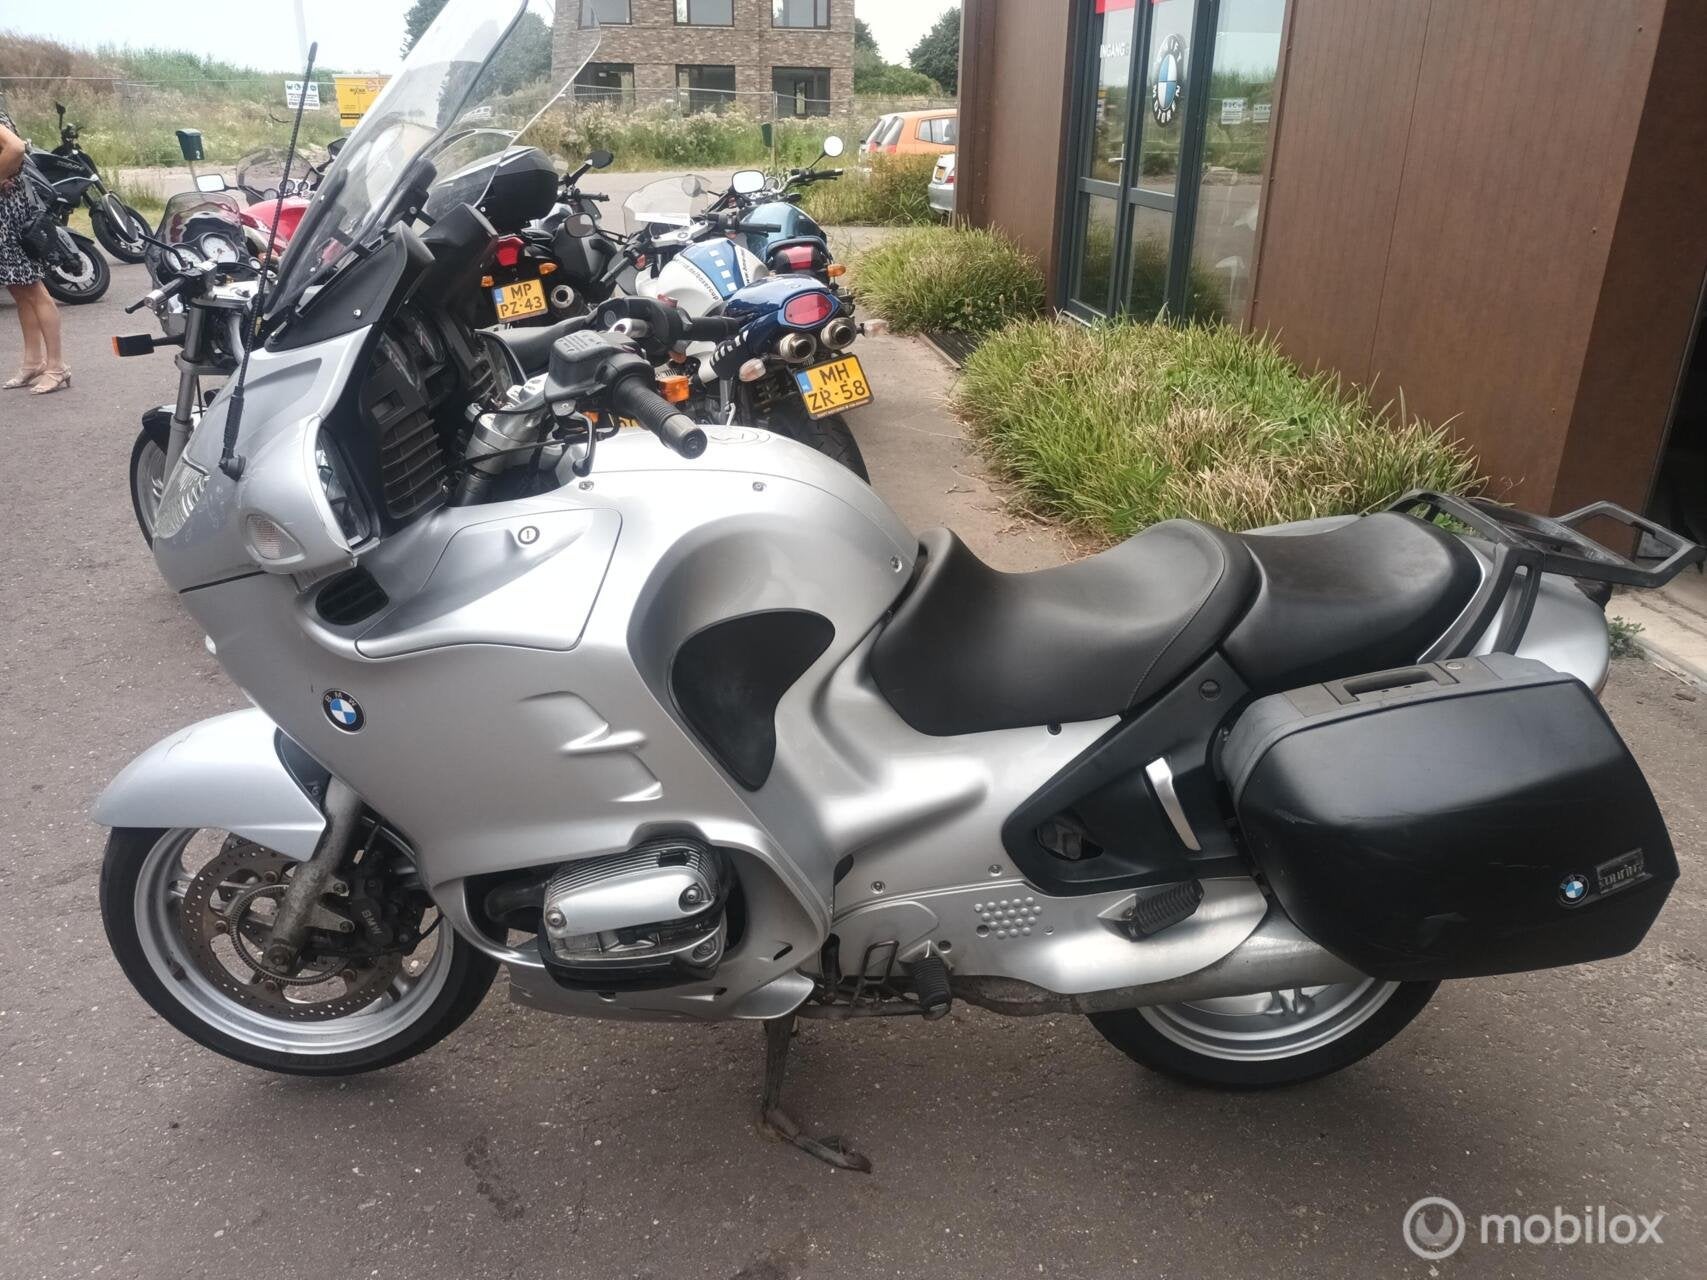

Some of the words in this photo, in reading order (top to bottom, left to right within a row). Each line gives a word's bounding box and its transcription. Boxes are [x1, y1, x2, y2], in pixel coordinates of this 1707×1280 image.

[510, 283, 532, 299] MP
[500, 296, 542, 317] PZ-43
[819, 362, 850, 385] MH
[808, 380, 866, 411] ZR-58
[324, 691, 357, 707] BMW
